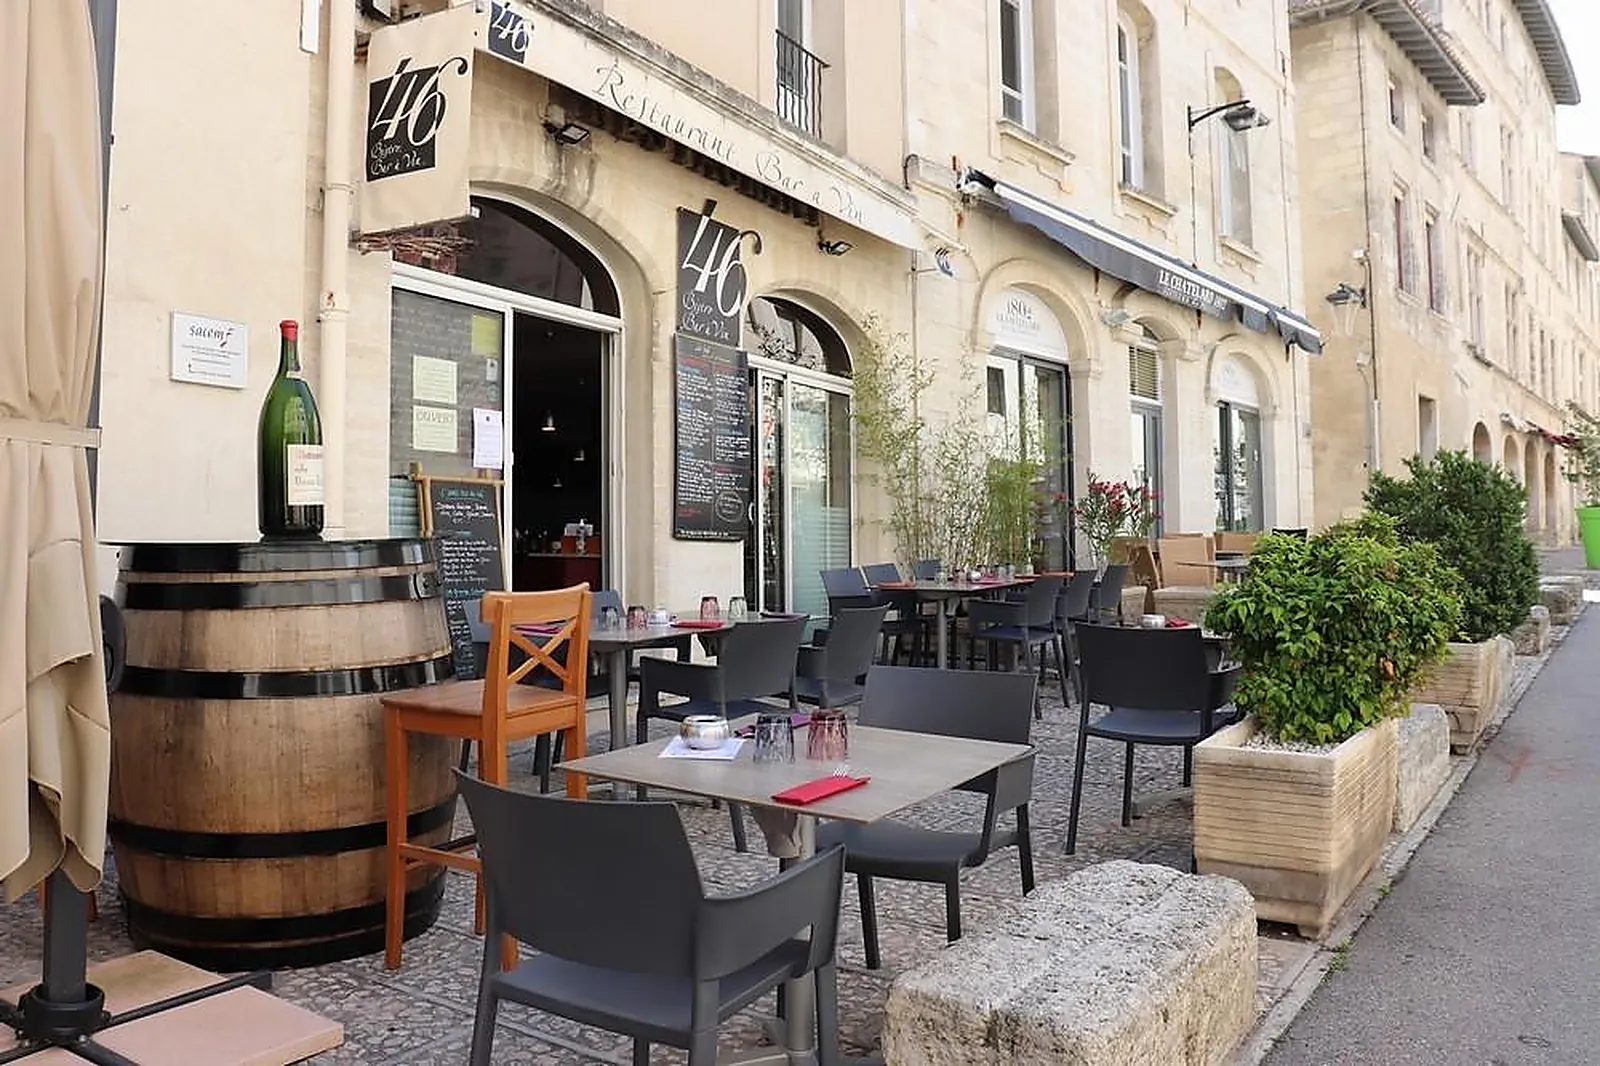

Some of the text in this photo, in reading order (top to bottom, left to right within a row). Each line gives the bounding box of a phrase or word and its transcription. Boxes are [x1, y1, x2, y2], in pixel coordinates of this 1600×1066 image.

[492, 2, 535, 52] 46
[371, 57, 468, 146] 46
[596, 58, 733, 163] Restaurant
[756, 152, 804, 190] Bar
[832, 185, 866, 223] Vin
[682, 199, 762, 317] 46
[1159, 269, 1170, 285] LE
